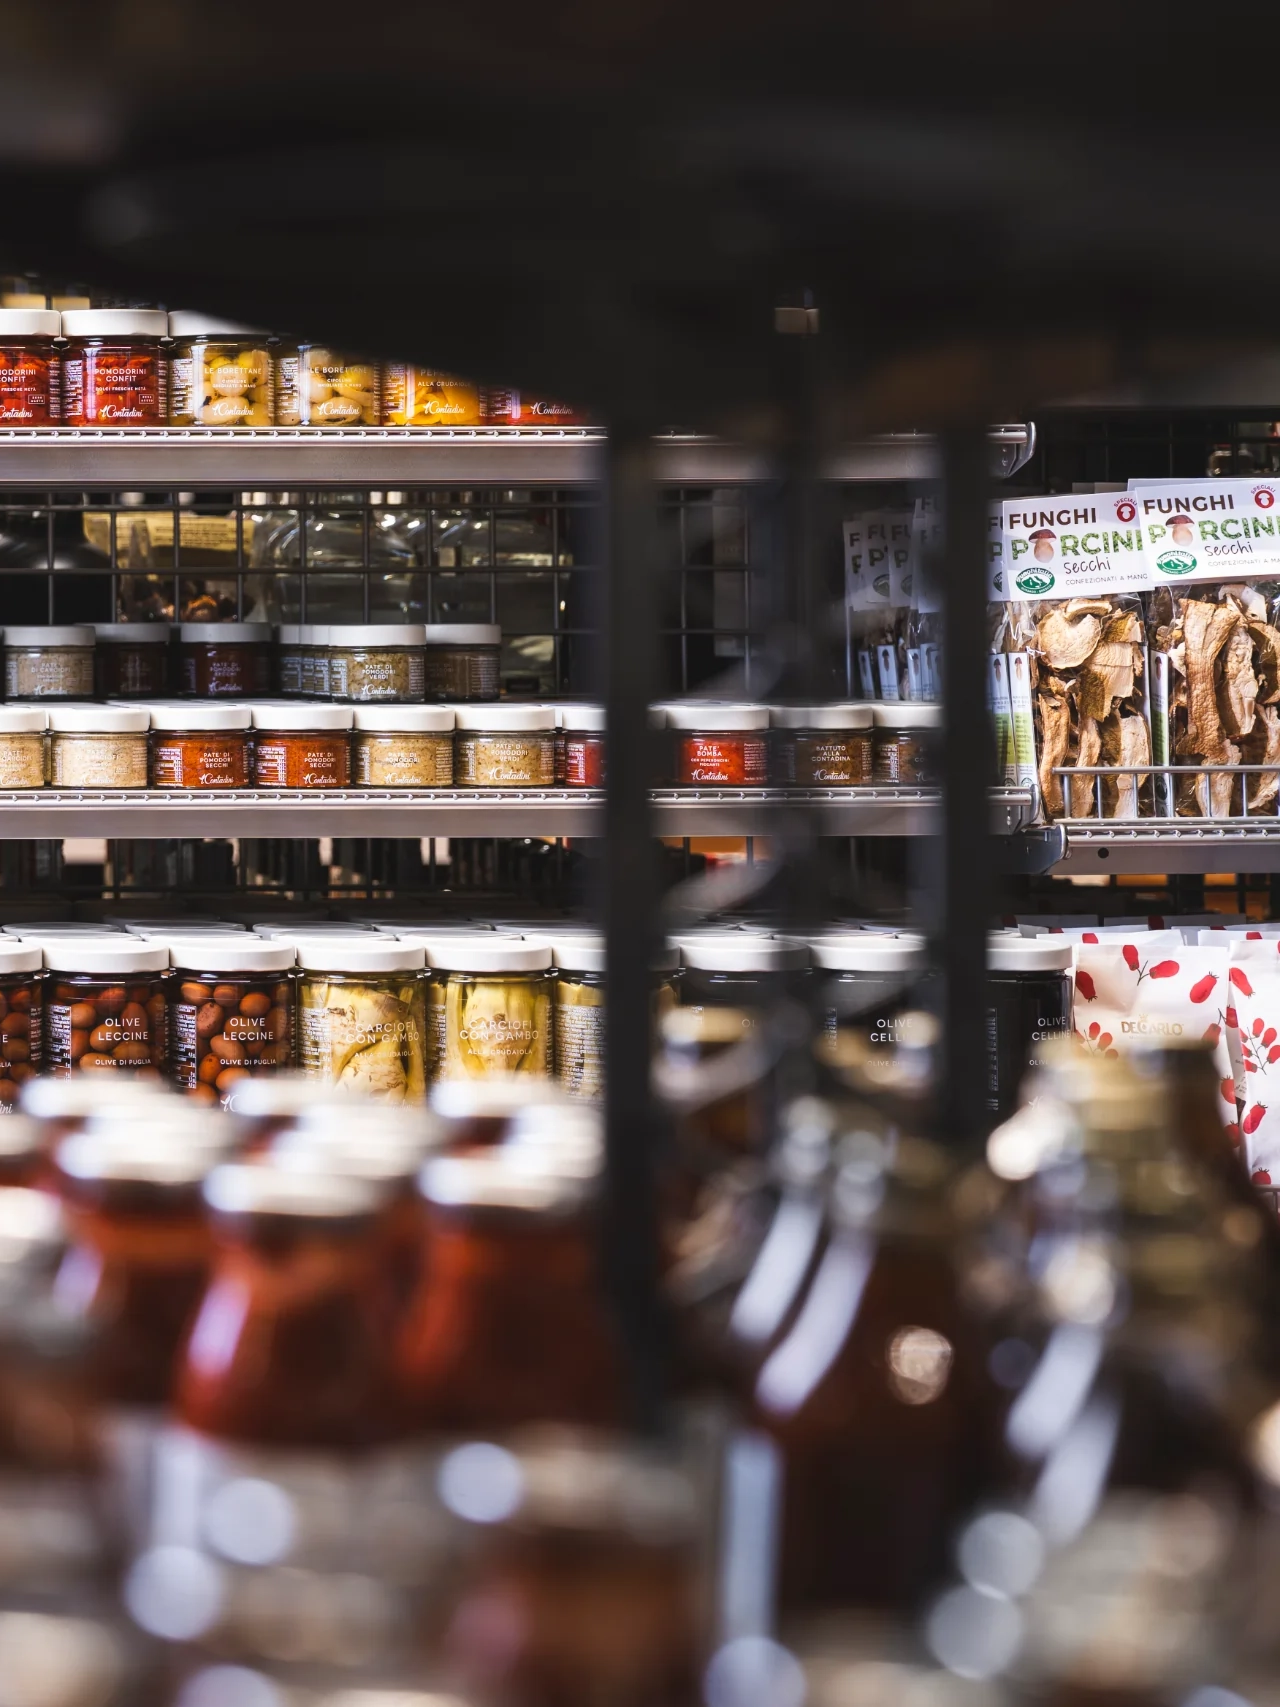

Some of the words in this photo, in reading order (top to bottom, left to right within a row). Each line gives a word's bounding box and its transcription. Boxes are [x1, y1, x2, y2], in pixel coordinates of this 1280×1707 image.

[95, 368, 147, 376] POMODORINI
[310, 366, 319, 374] LE
[1142, 494, 1234, 515] FUNGHI
[1008, 507, 1097, 530] FUNGHI
[1204, 540, 1254, 558] secchi
[1063, 556, 1111, 575] secchi
[104, 1018, 140, 1027] OLIVE
[230, 1018, 266, 1027] OLIVE
[355, 1021, 414, 1033] CARCIOFI
[469, 1020, 532, 1030] CARCIOFI
[876, 1019, 912, 1028] OLIVE
[1038, 1016, 1066, 1027] OLIVE
[98, 1031, 149, 1041] LECCINE
[223, 1031, 274, 1041] LECCINE
[345, 1033, 376, 1044] CON
[382, 1032, 419, 1042] GAMBO
[460, 1030, 488, 1041] CON
[495, 1030, 539, 1040] GAMBO
[1032, 1030, 1071, 1041] CELLINE
